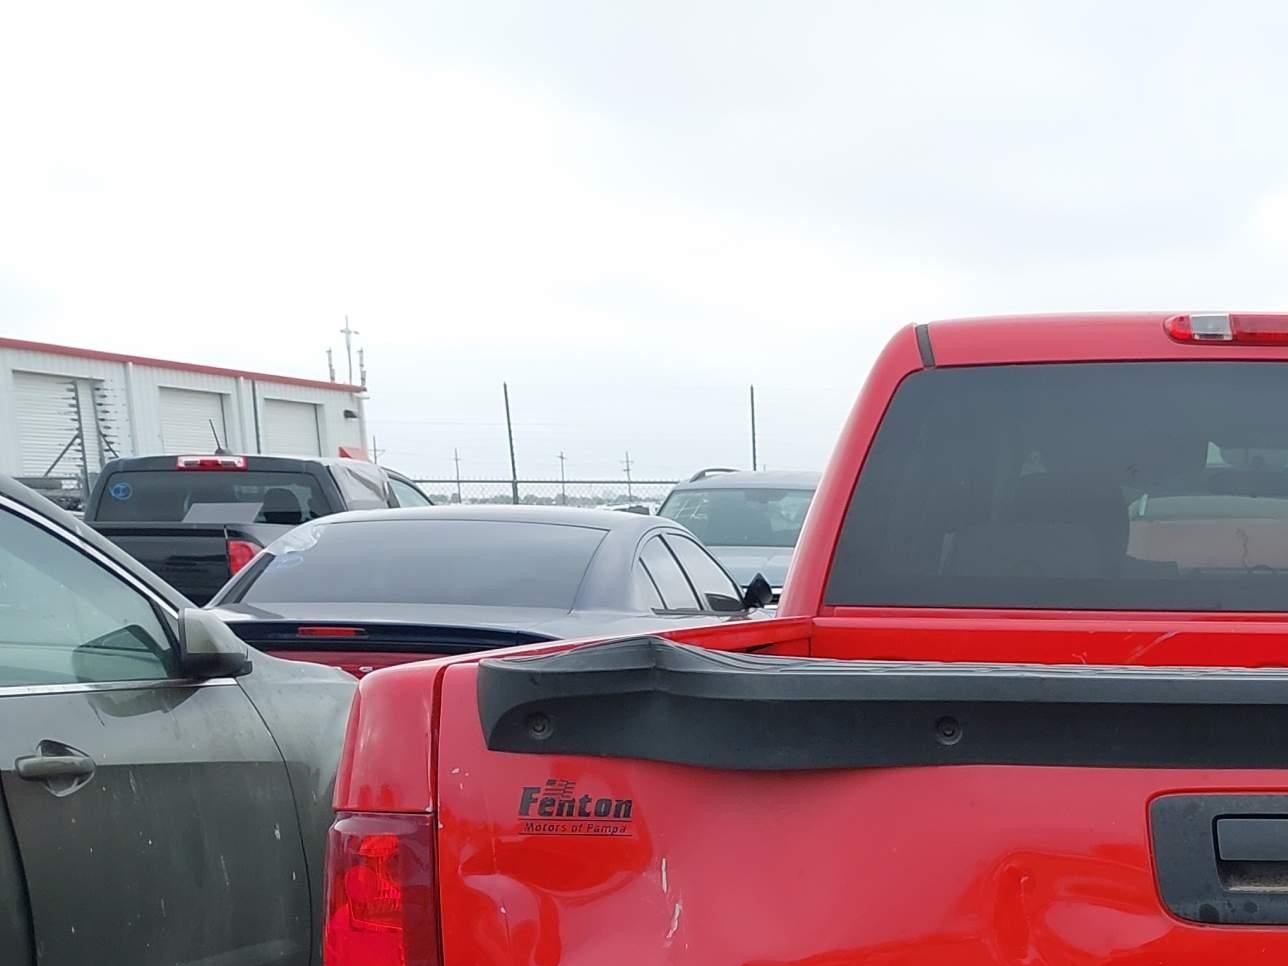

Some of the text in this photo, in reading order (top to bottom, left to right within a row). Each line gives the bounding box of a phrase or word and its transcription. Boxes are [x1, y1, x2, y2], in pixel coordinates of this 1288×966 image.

[518, 786, 633, 819] Fenton
[524, 822, 627, 835] Motors of Pampa
